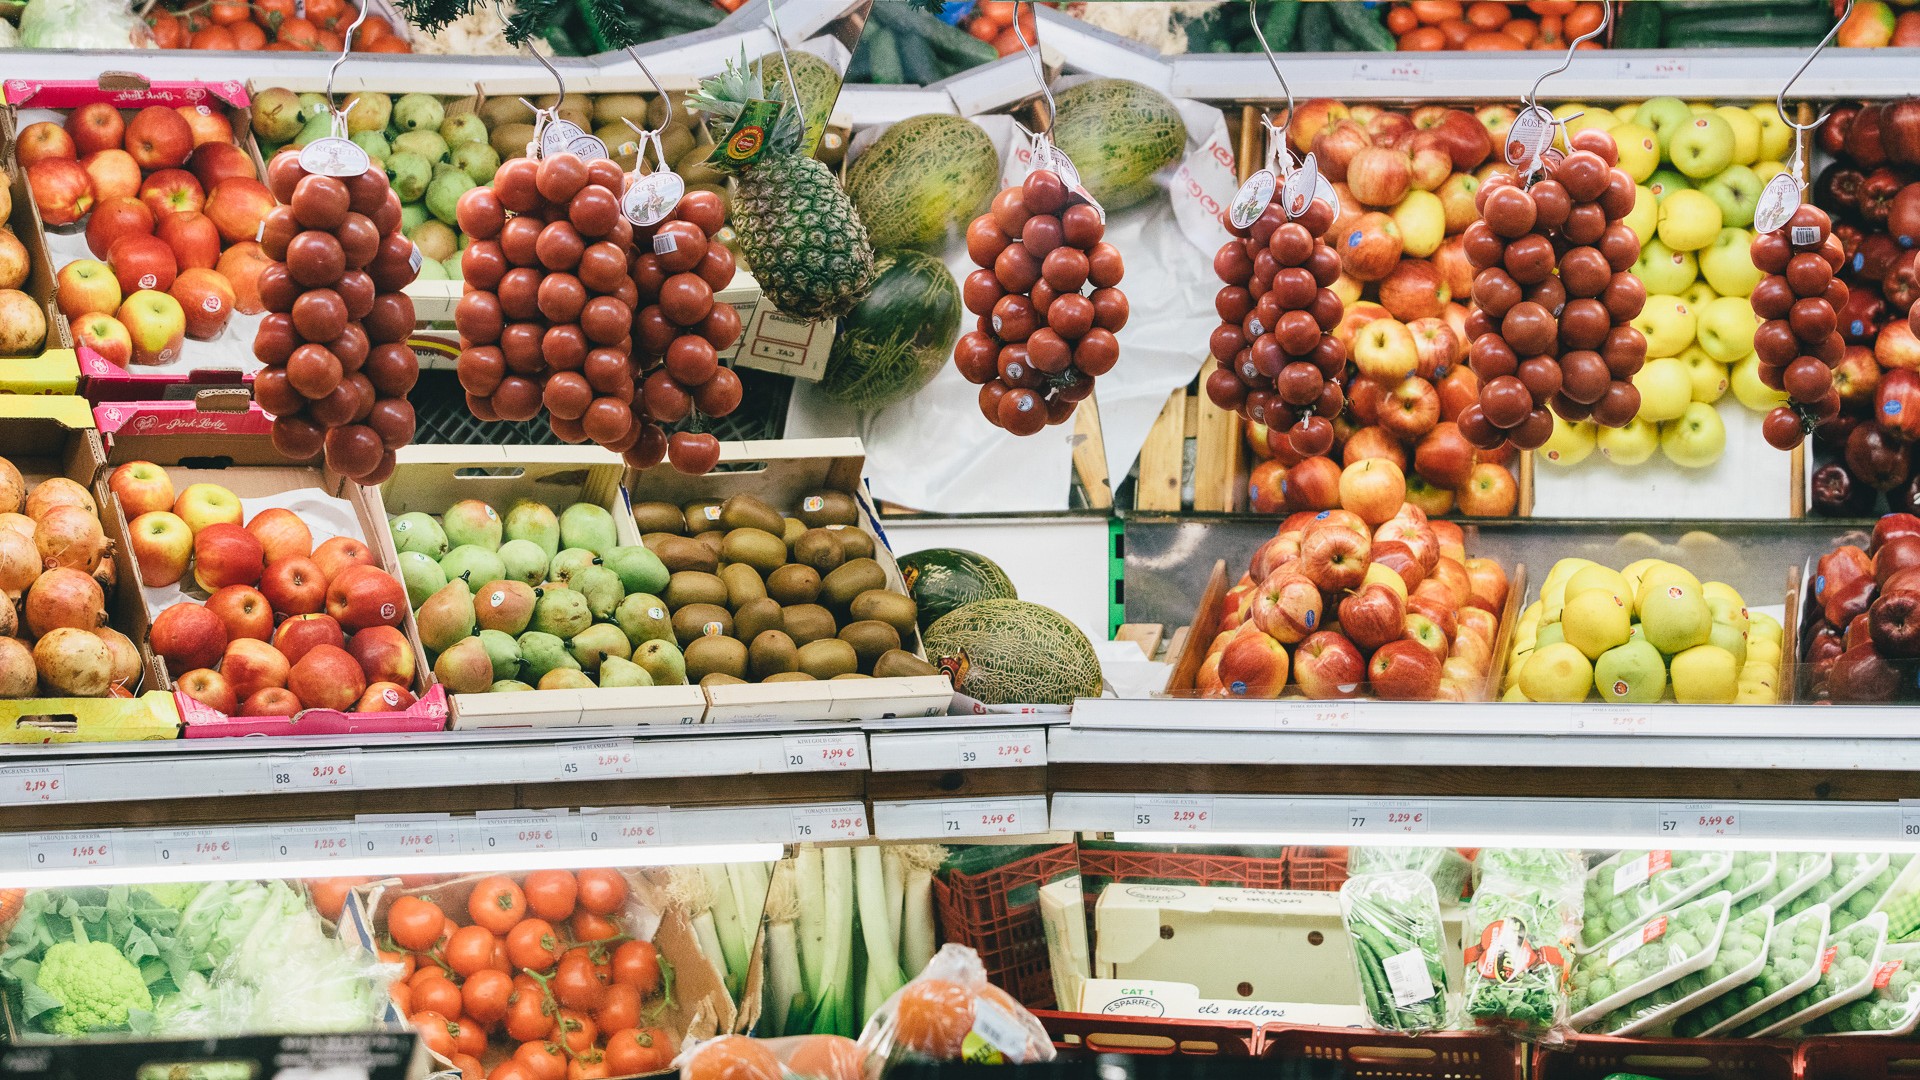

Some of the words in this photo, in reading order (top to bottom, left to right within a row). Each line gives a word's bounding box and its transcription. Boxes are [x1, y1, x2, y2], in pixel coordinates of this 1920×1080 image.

[546, 128, 579, 145] ROETA
[315, 145, 359, 157] ROSETA
[634, 176, 674, 195] ROSETA
[1246, 179, 1272, 190] ROSETA
[1769, 184, 1796, 195] ROSETA
[166, 418, 197, 430] Pink
[196, 418, 227, 430] Lady
[822, 749, 843, 759] 7,99
[846, 748, 855, 757] €
[998, 746, 1019, 755] 2,79
[1023, 745, 1031, 754] €
[623, 753, 631, 763] €
[790, 755, 803, 765] 20
[963, 752, 976, 762] 39
[312, 766, 334, 777] 3,19
[338, 765, 346, 774] €
[565, 763, 578, 773] 45
[276, 773, 290, 784] 88
[25, 781, 46, 792] 2,19
[51, 780, 59, 789] €
[982, 815, 1003, 825] 2,49
[1007, 814, 1015, 823] €
[1137, 815, 1150, 824] 55
[1173, 811, 1195, 821] 2,29
[1198, 811, 1207, 820] €
[1388, 813, 1410, 823] 2,29
[1414, 813, 1423, 822] €
[1726, 816, 1735, 825] €
[831, 819, 851, 829] 3,29
[855, 818, 863, 827] €
[947, 821, 960, 830] 71
[1352, 818, 1365, 827] 77
[1663, 821, 1677, 831] 57
[798, 825, 811, 835] 76
[1905, 824, 1920, 835] 80
[591, 832, 598, 841] 0
[367, 841, 374, 851] 0
[488, 837, 496, 847] 0
[163, 850, 170, 859] 0
[280, 846, 287, 855] 0
[38, 853, 45, 863] 0
[1121, 988, 1144, 996] CAT
[1108, 999, 1159, 1013] ESPARREC
[1198, 1003, 1219, 1014] els
[1227, 1004, 1285, 1017] millors
